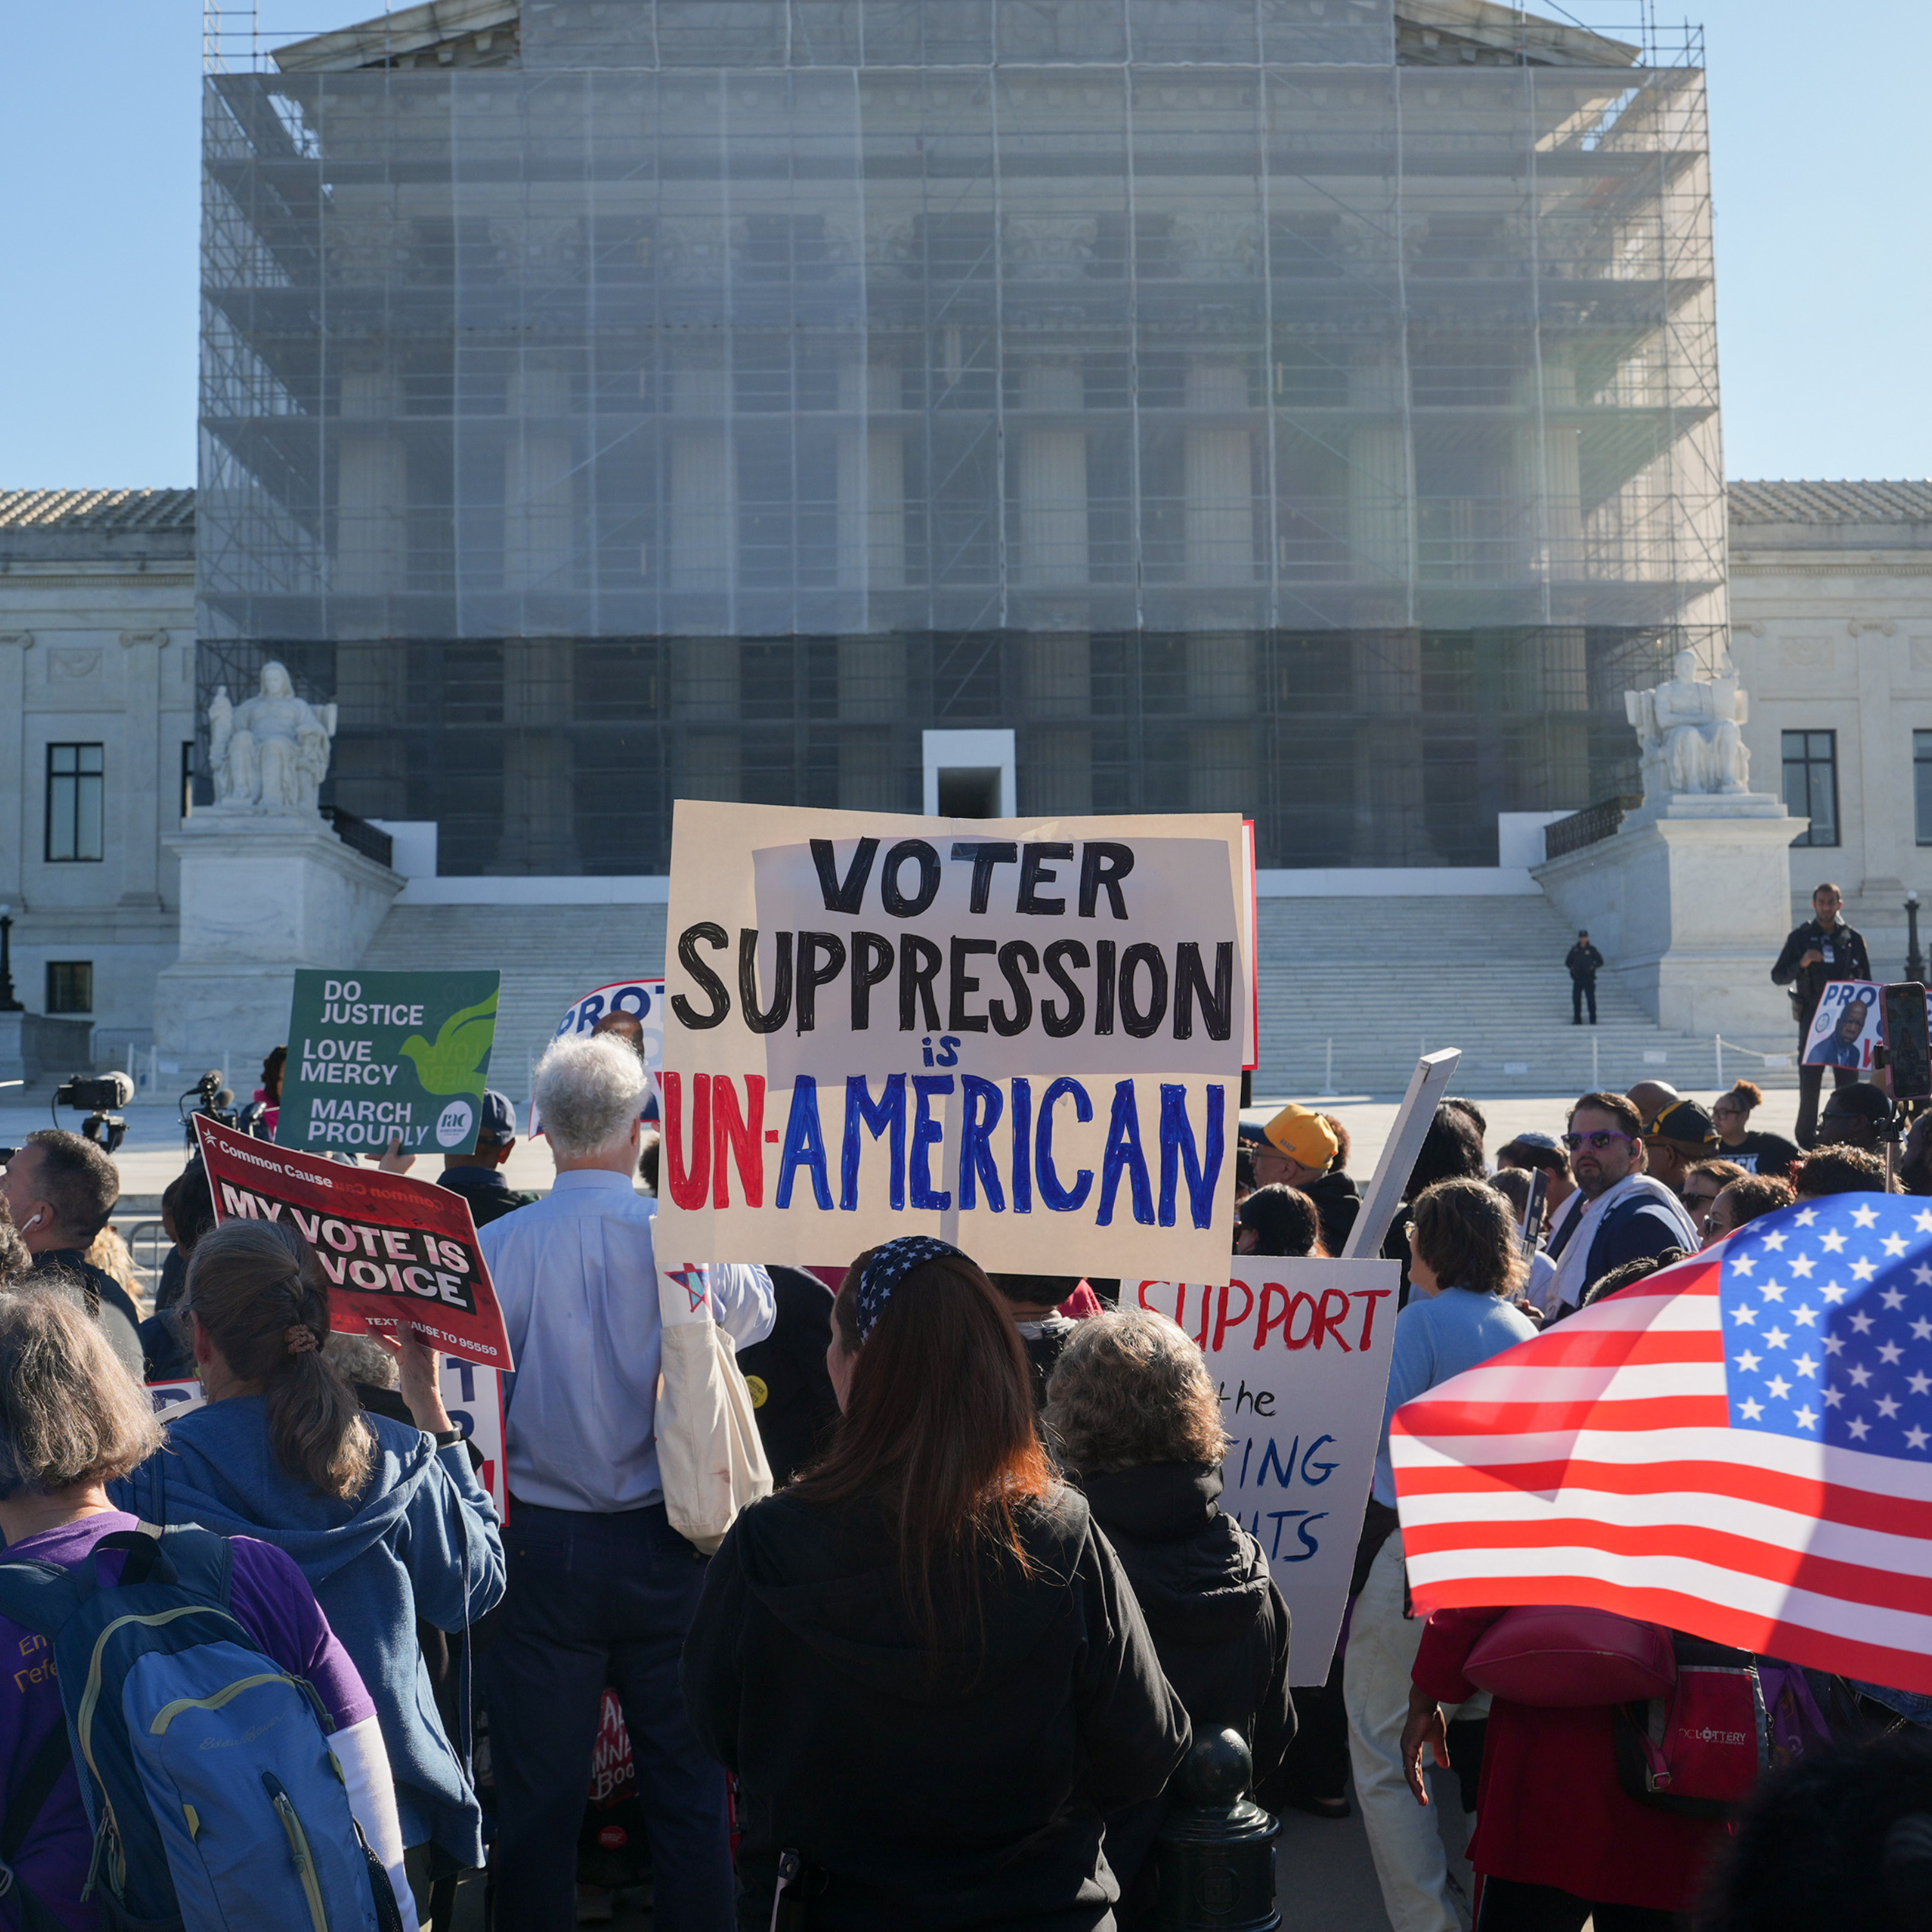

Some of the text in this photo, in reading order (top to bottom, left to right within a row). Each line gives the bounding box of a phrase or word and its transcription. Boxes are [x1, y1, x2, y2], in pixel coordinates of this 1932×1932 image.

[810, 836, 1135, 920] VOTER
[324, 980, 361, 1001] DO
[670, 922, 1233, 1041] SUPPRESSION
[321, 1003, 424, 1026] JUSTICE
[554, 986, 665, 1043] PRO
[300, 1061, 398, 1085] MERCY
[303, 1038, 372, 1061] LOVE
[307, 1121, 430, 1146] PROUDLY
[311, 1098, 412, 1123] MARCH
[220, 1140, 333, 1188] Common Cause
[663, 1070, 1225, 1229] UN-AMERICAN
[221, 1182, 470, 1274] MY VOTE IS
[316, 1250, 468, 1308] VOICE
[365, 1317, 399, 1327] TEXT
[409, 1320, 440, 1339] AUSE
[441, 1331, 457, 1344] TO
[459, 1338, 498, 1356] 95559
[1226, 1434, 1341, 1489] ING
